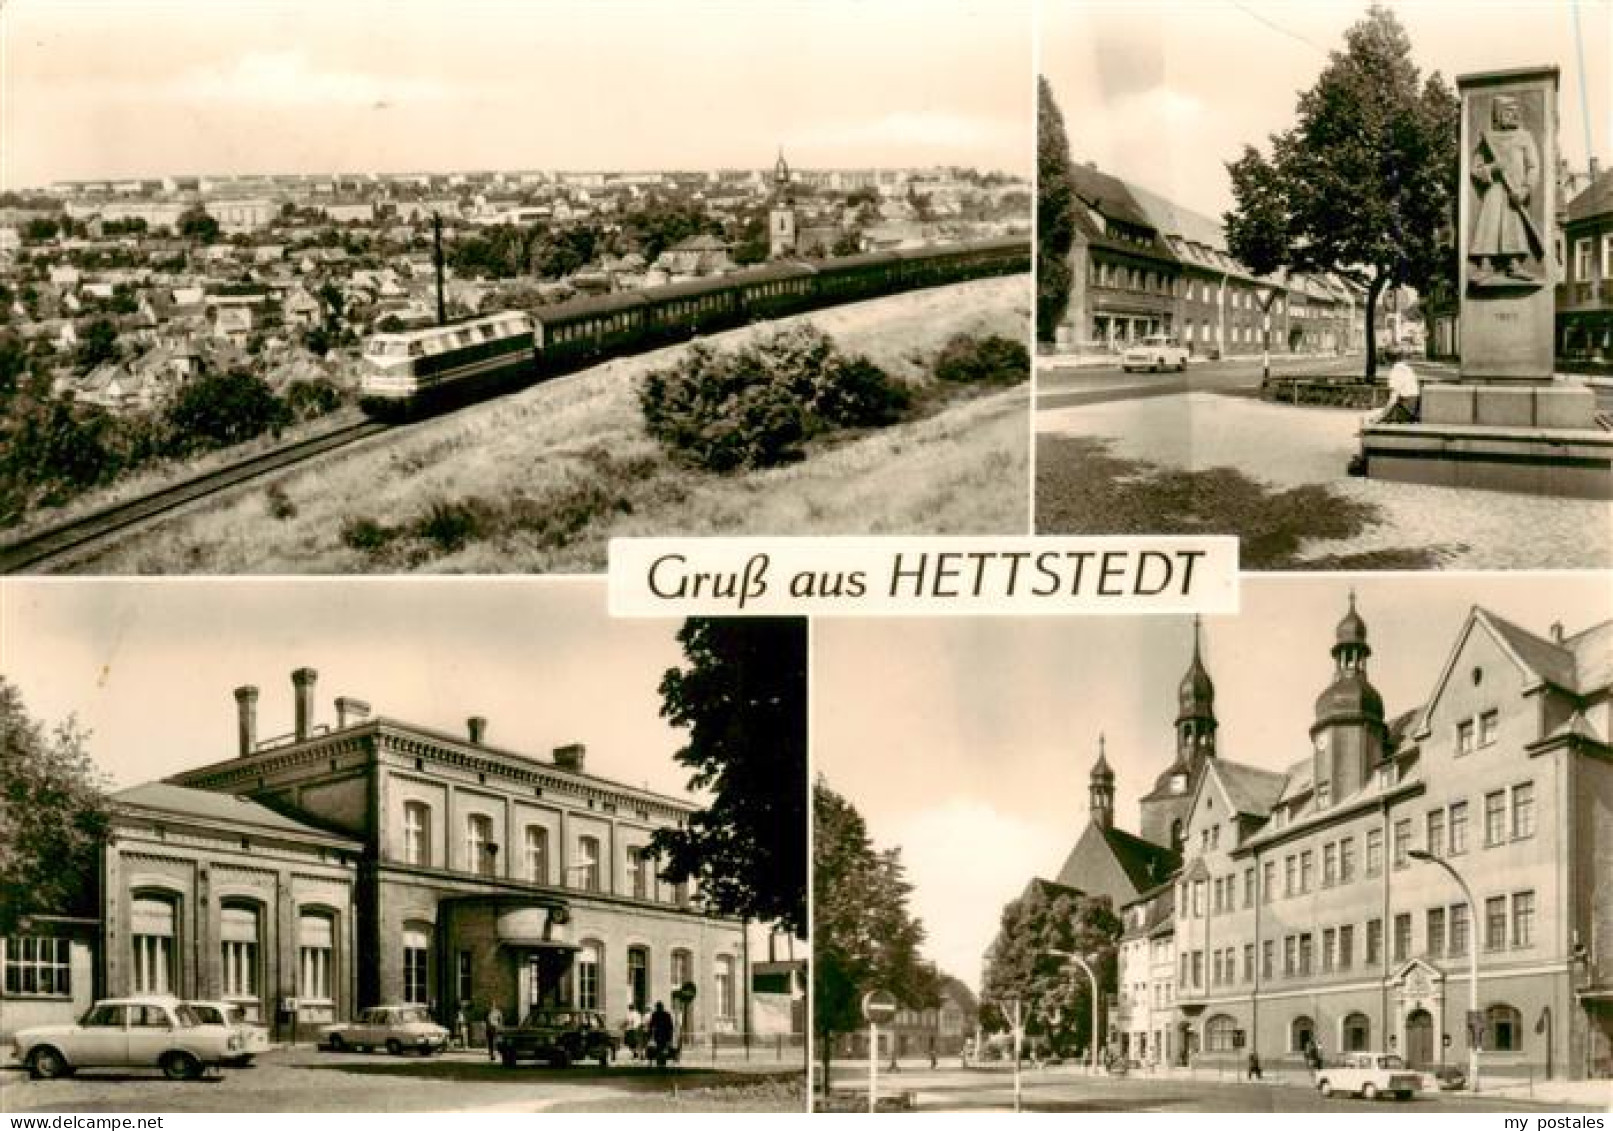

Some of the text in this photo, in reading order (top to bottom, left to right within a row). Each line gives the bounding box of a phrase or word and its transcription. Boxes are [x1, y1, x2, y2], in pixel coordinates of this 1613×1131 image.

[648, 551, 1206, 608] Gruß aus HETTSTEDT
